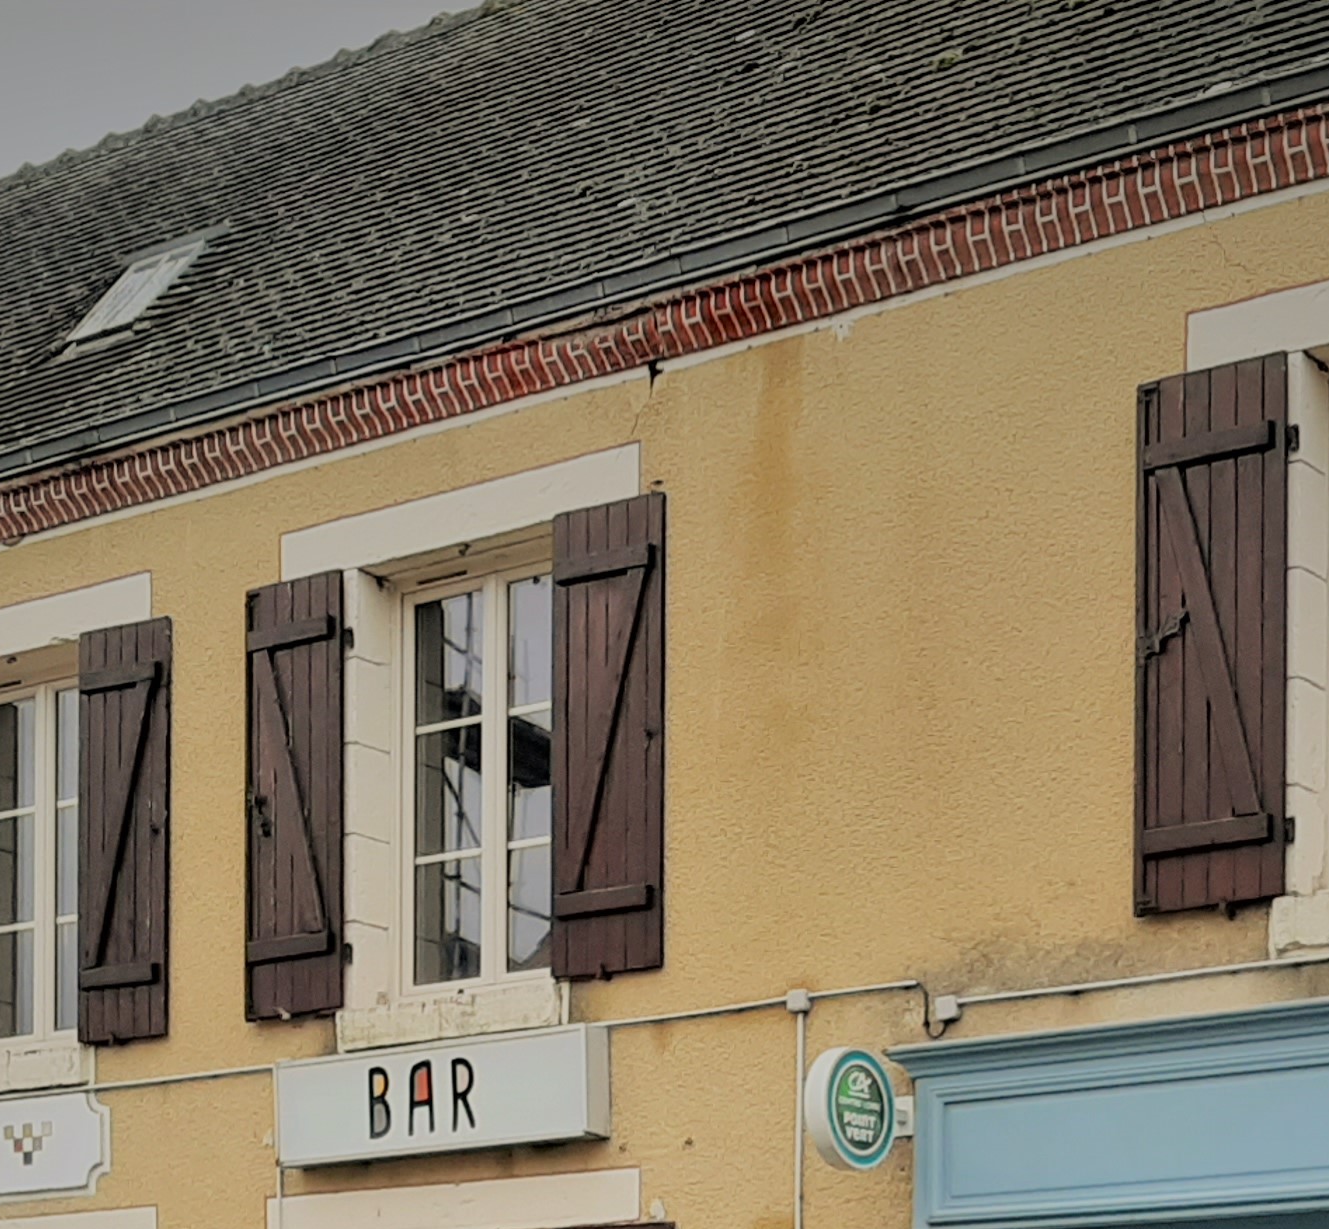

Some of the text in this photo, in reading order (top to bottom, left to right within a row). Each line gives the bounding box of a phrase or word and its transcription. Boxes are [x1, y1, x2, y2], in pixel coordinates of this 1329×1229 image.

[368, 1057, 476, 1139] BAR
[843, 1111, 877, 1129] POINT
[845, 1125, 874, 1143] VERT
